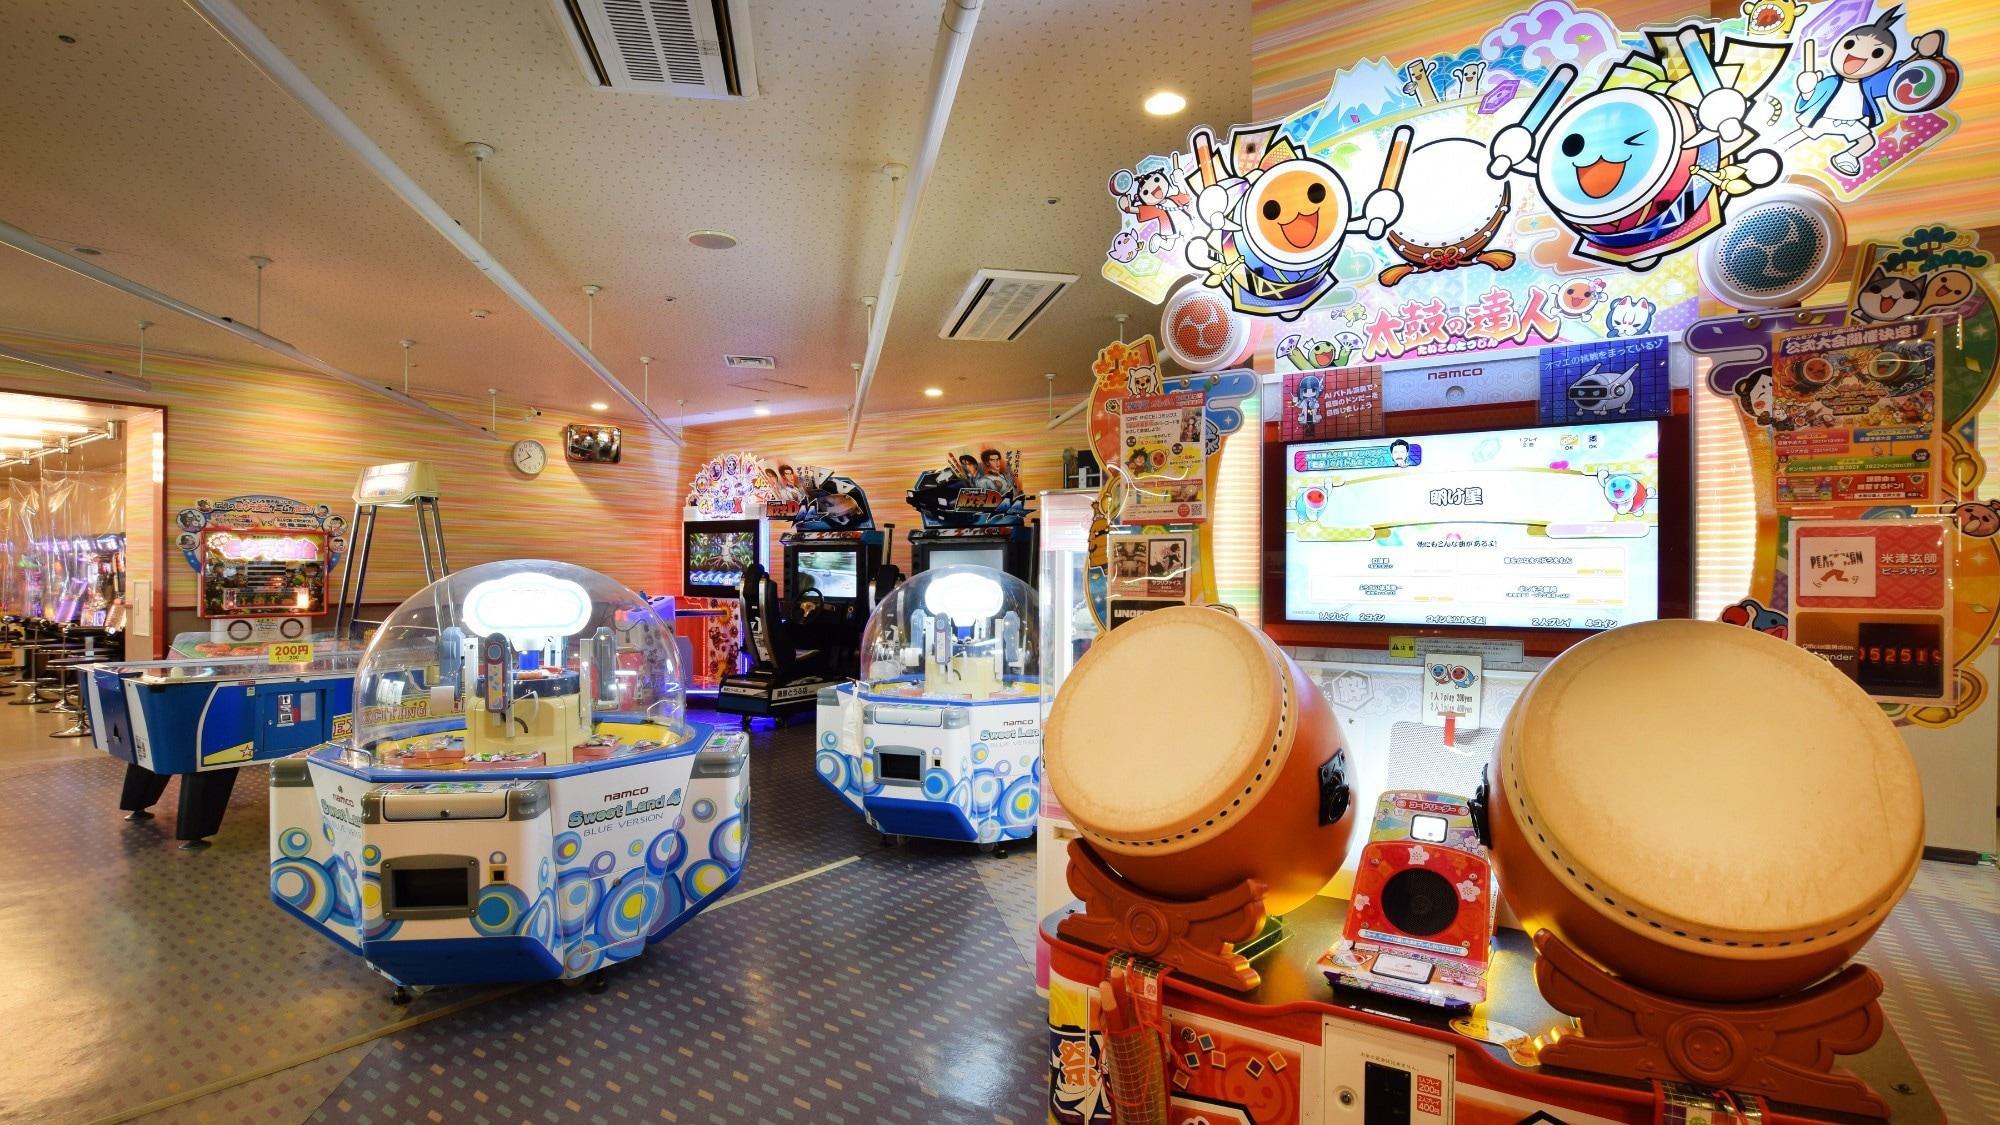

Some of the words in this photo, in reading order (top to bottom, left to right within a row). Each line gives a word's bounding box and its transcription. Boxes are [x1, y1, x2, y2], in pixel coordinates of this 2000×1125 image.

[1363, 286, 1561, 361] 太鼓の達人
[1416, 338, 1499, 356] たいこのたつじん
[1544, 339, 1664, 370] オマエの挑戦をまっているゾ
[1427, 368, 1483, 380] namco
[1430, 487, 1483, 506] 明け星
[1881, 552, 1937, 565] 米津玄師
[1318, 612, 1349, 621] 1人プレイ
[1359, 613, 1385, 621] 2コイン
[1531, 618, 1571, 627] 2人プレイ
[1585, 619, 1618, 628] 4コイン
[275, 645, 309, 656] 200円
[1003, 719, 1034, 727] namco
[980, 729, 1016, 741] Sweet
[1018, 727, 1040, 738] Lan
[332, 793, 355, 808] namco
[604, 787, 649, 802] namco
[568, 804, 623, 829] Sweet
[625, 795, 665, 816] Land
[667, 788, 681, 806] 4
[1409, 801, 1456, 813] コードリーダー
[583, 824, 613, 837] BLUE
[618, 812, 664, 829] VERSION
[1058, 1039, 1098, 1088] 祭
[1418, 1076, 1440, 1087] 1人プレイ
[1418, 1083, 1440, 1096] 200円
[1418, 1096, 1440, 1107] 2人プレイ
[1418, 1103, 1440, 1115] 400円
